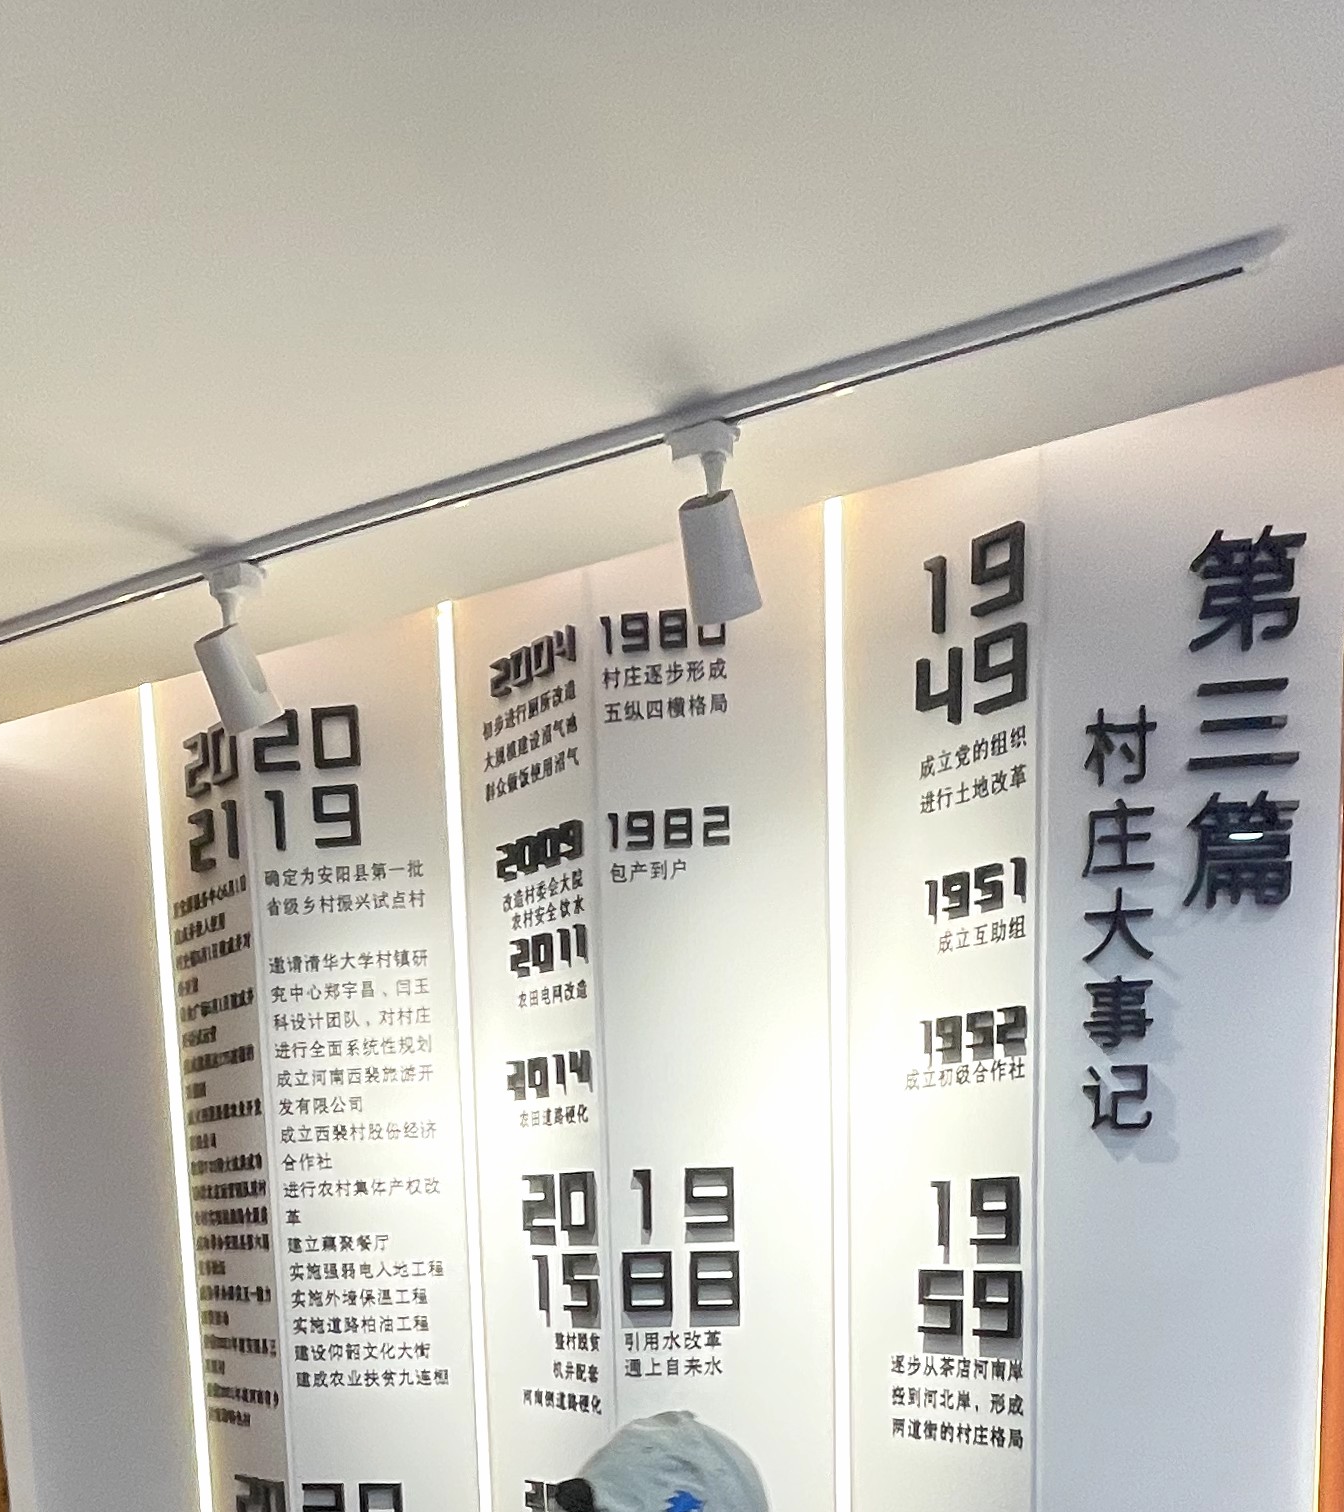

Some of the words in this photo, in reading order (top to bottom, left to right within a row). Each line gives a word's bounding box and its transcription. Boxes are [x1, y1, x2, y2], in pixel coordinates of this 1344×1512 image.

[923, 519, 1026, 635] 19
[489, 624, 576, 698] 2004
[602, 658, 727, 689] 村庄逐步形成
[915, 621, 1028, 725] 49
[603, 693, 728, 724] 五纵四横格局
[1182, 524, 1308, 911] 第三篇
[253, 704, 361, 772] 20
[919, 725, 1028, 781] 成立党的组织
[919, 764, 1028, 815] 进行土地改革
[264, 783, 361, 851] 19
[608, 805, 730, 851] 1982
[188, 799, 239, 873] 21
[495, 818, 584, 883] 2009
[264, 859, 424, 888] 确定为安阳县第一批
[609, 859, 687, 883] 包产到户
[266, 889, 425, 917] 省级乡村振兴试点村
[502, 868, 583, 913] 改造村委会大院
[925, 857, 1027, 923] 1951
[511, 894, 585, 931] 农村安全饮水
[1081, 704, 1157, 1131] 村庄大事记
[509, 922, 589, 978] 2011
[937, 914, 1027, 956] 成立互助组
[268, 949, 428, 975] 邀请清华大学村镇研
[517, 979, 588, 1008] 农田电网改造
[274, 1034, 433, 1060] 进行全面系统性规划
[919, 1005, 1027, 1066] 1952
[276, 1063, 434, 1088] 成立河南西裴旅游开
[506, 1049, 593, 1101] 2014
[905, 1057, 1026, 1091] 成立初级合作社
[278, 1096, 363, 1117] 发有限公司
[519, 1103, 589, 1128] 农田道路硬化
[280, 1121, 437, 1144] 成立西裴村股份经济
[281, 1152, 333, 1172] 合作社
[283, 1177, 441, 1198] 进行农村集体产权改
[630, 1167, 734, 1238] 19
[286, 1209, 301, 1226] 革
[522, 1171, 598, 1242] 20
[930, 1175, 1021, 1258] 19
[289, 1260, 444, 1281] 实施强弱电入地工程
[621, 1250, 740, 1325] 88
[291, 1288, 427, 1308] 实施外墙保温工程
[532, 1253, 601, 1327] 15
[917, 1269, 1023, 1346] 59
[293, 1315, 429, 1335] 实施道路柏油工程
[554, 1332, 600, 1352] 整村脱贫
[624, 1330, 722, 1352] 引用水改革
[294, 1342, 431, 1362] 建设仰韶文化大街
[891, 1355, 1023, 1382] 逐步从茶店河南岸
[553, 1362, 599, 1384] 机井配套
[892, 1418, 1023, 1449] 两道街的村庄格局
